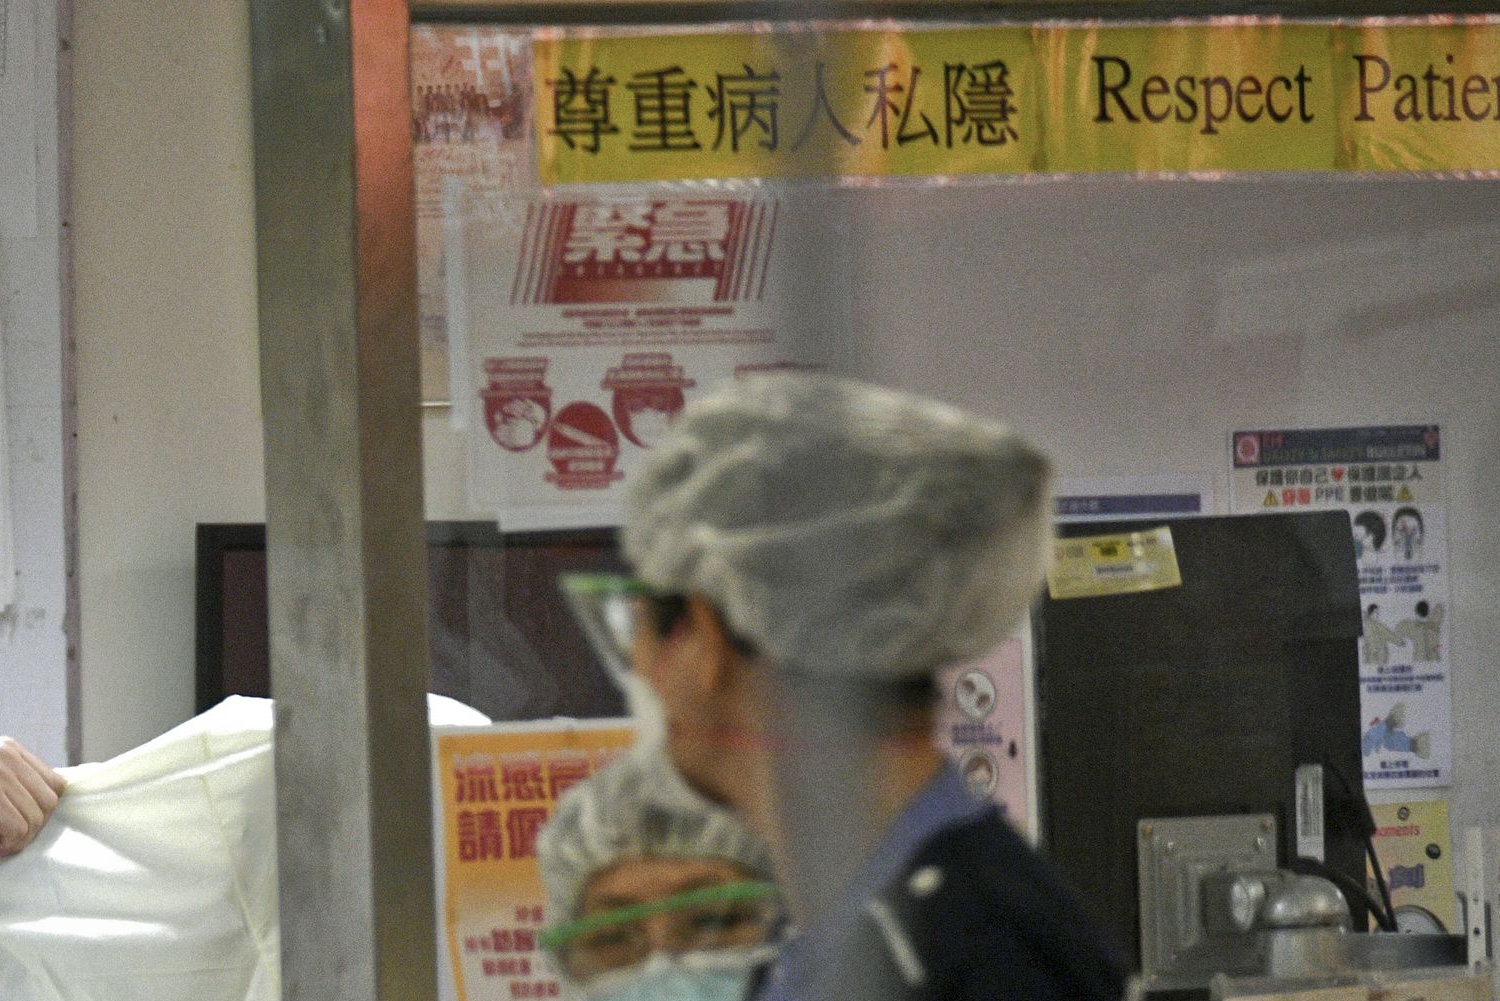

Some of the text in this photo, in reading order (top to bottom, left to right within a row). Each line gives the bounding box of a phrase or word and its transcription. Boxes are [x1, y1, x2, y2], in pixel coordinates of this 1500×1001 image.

[545, 58, 1022, 156] 尊重病人私隱
[1092, 55, 1314, 134] Respect
